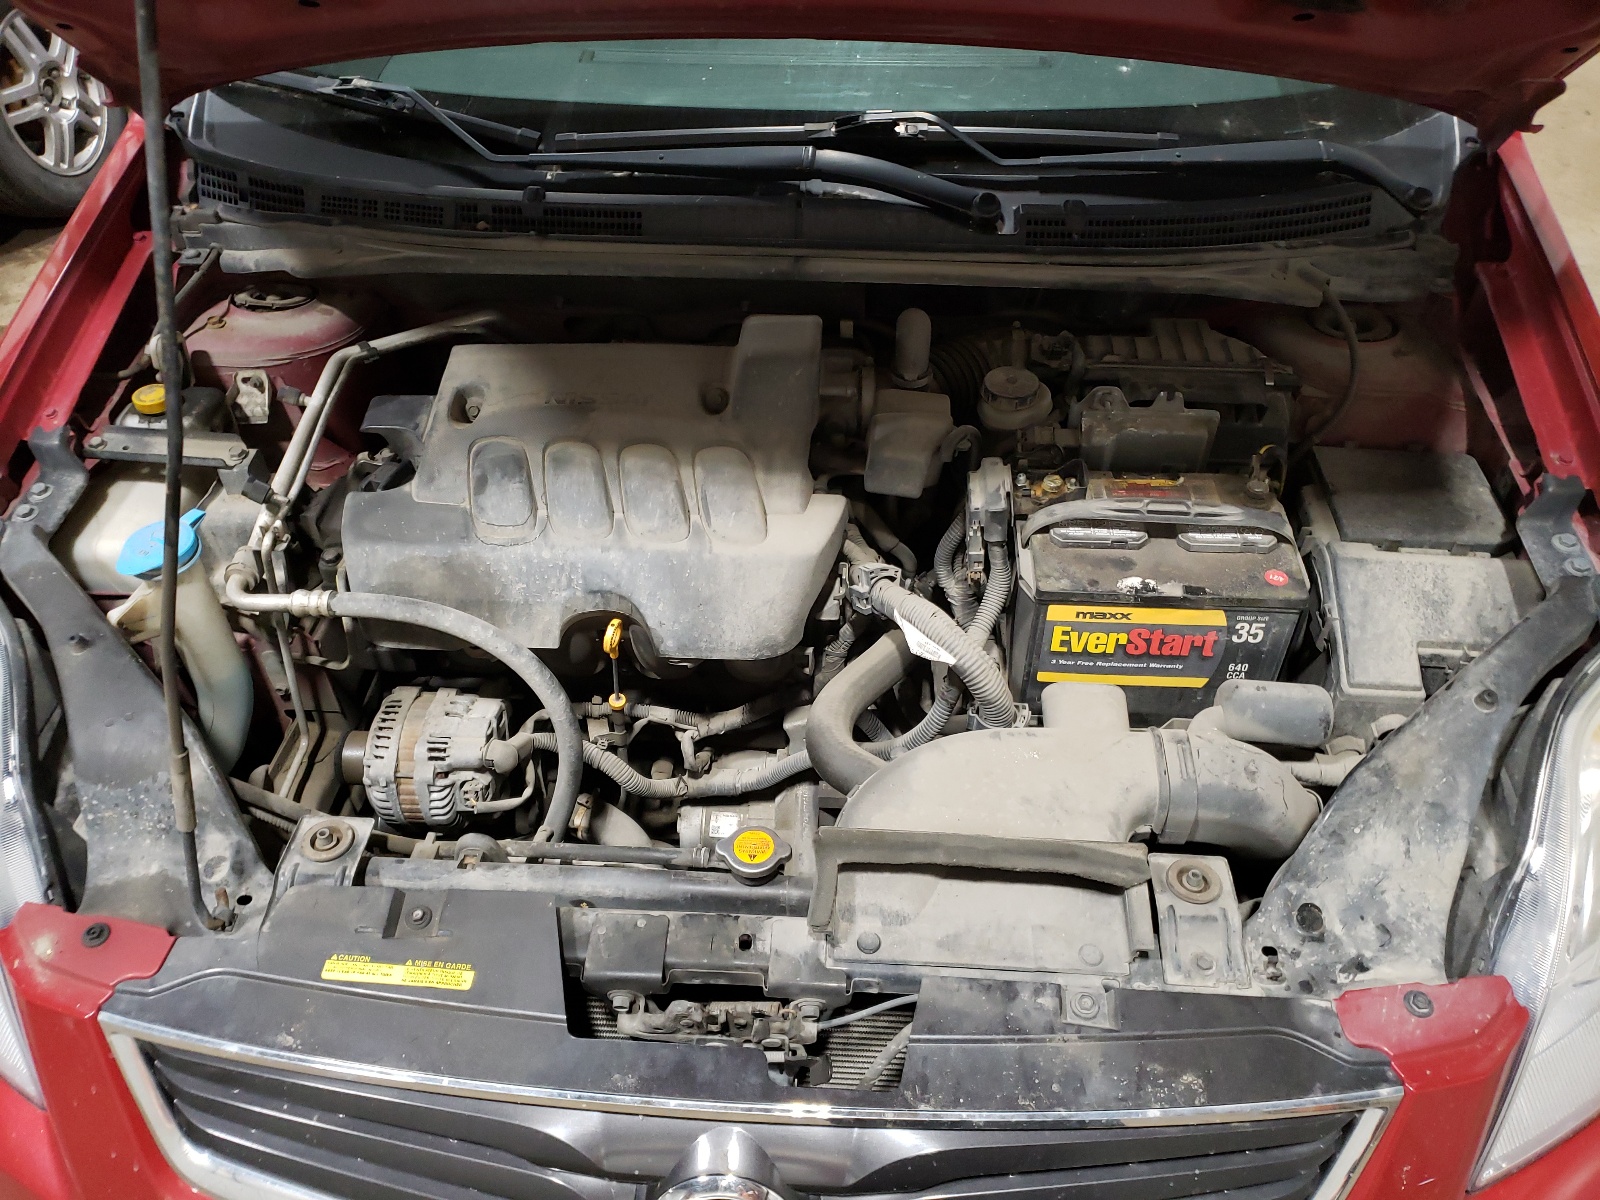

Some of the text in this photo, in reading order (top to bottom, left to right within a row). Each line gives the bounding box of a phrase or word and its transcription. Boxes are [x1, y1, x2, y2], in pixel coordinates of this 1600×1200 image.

[1076, 610, 1133, 622] maxx
[1232, 622, 1266, 644] 35
[1050, 624, 1219, 657] EverStart
[1149, 662, 1184, 670] Warranty
[1228, 663, 1249, 672] 640
[1226, 671, 1246, 680] CCA
[338, 954, 371, 963] CAUTION
[414, 959, 472, 971] MISE EN GARDE
